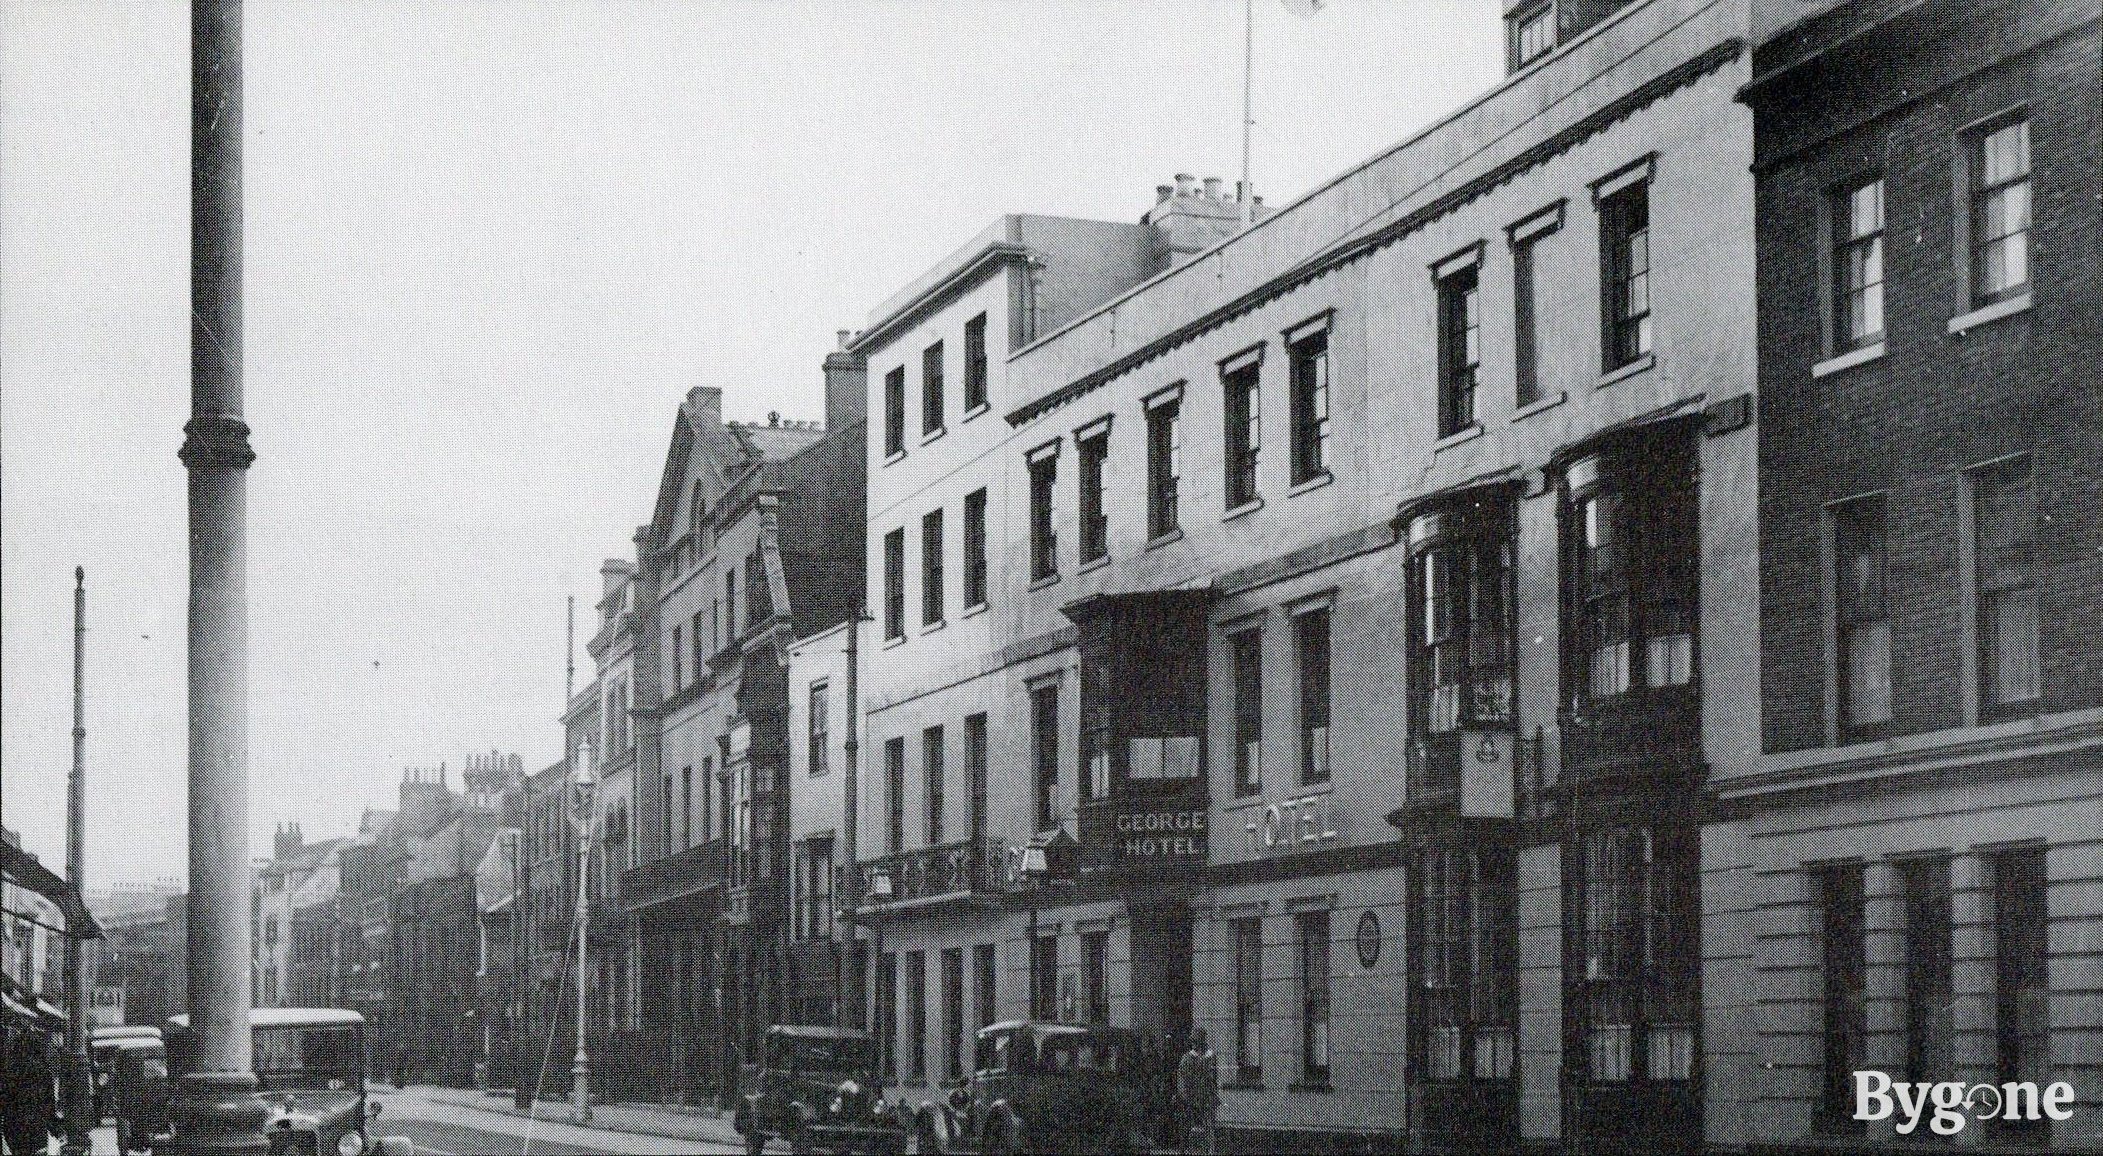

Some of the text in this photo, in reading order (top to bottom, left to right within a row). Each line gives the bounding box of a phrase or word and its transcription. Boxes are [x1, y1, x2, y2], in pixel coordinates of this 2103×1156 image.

[1116, 811, 1205, 832] GEORGE
[1246, 796, 1338, 857] HOTEL
[1125, 837, 1200, 856] HOTEL
